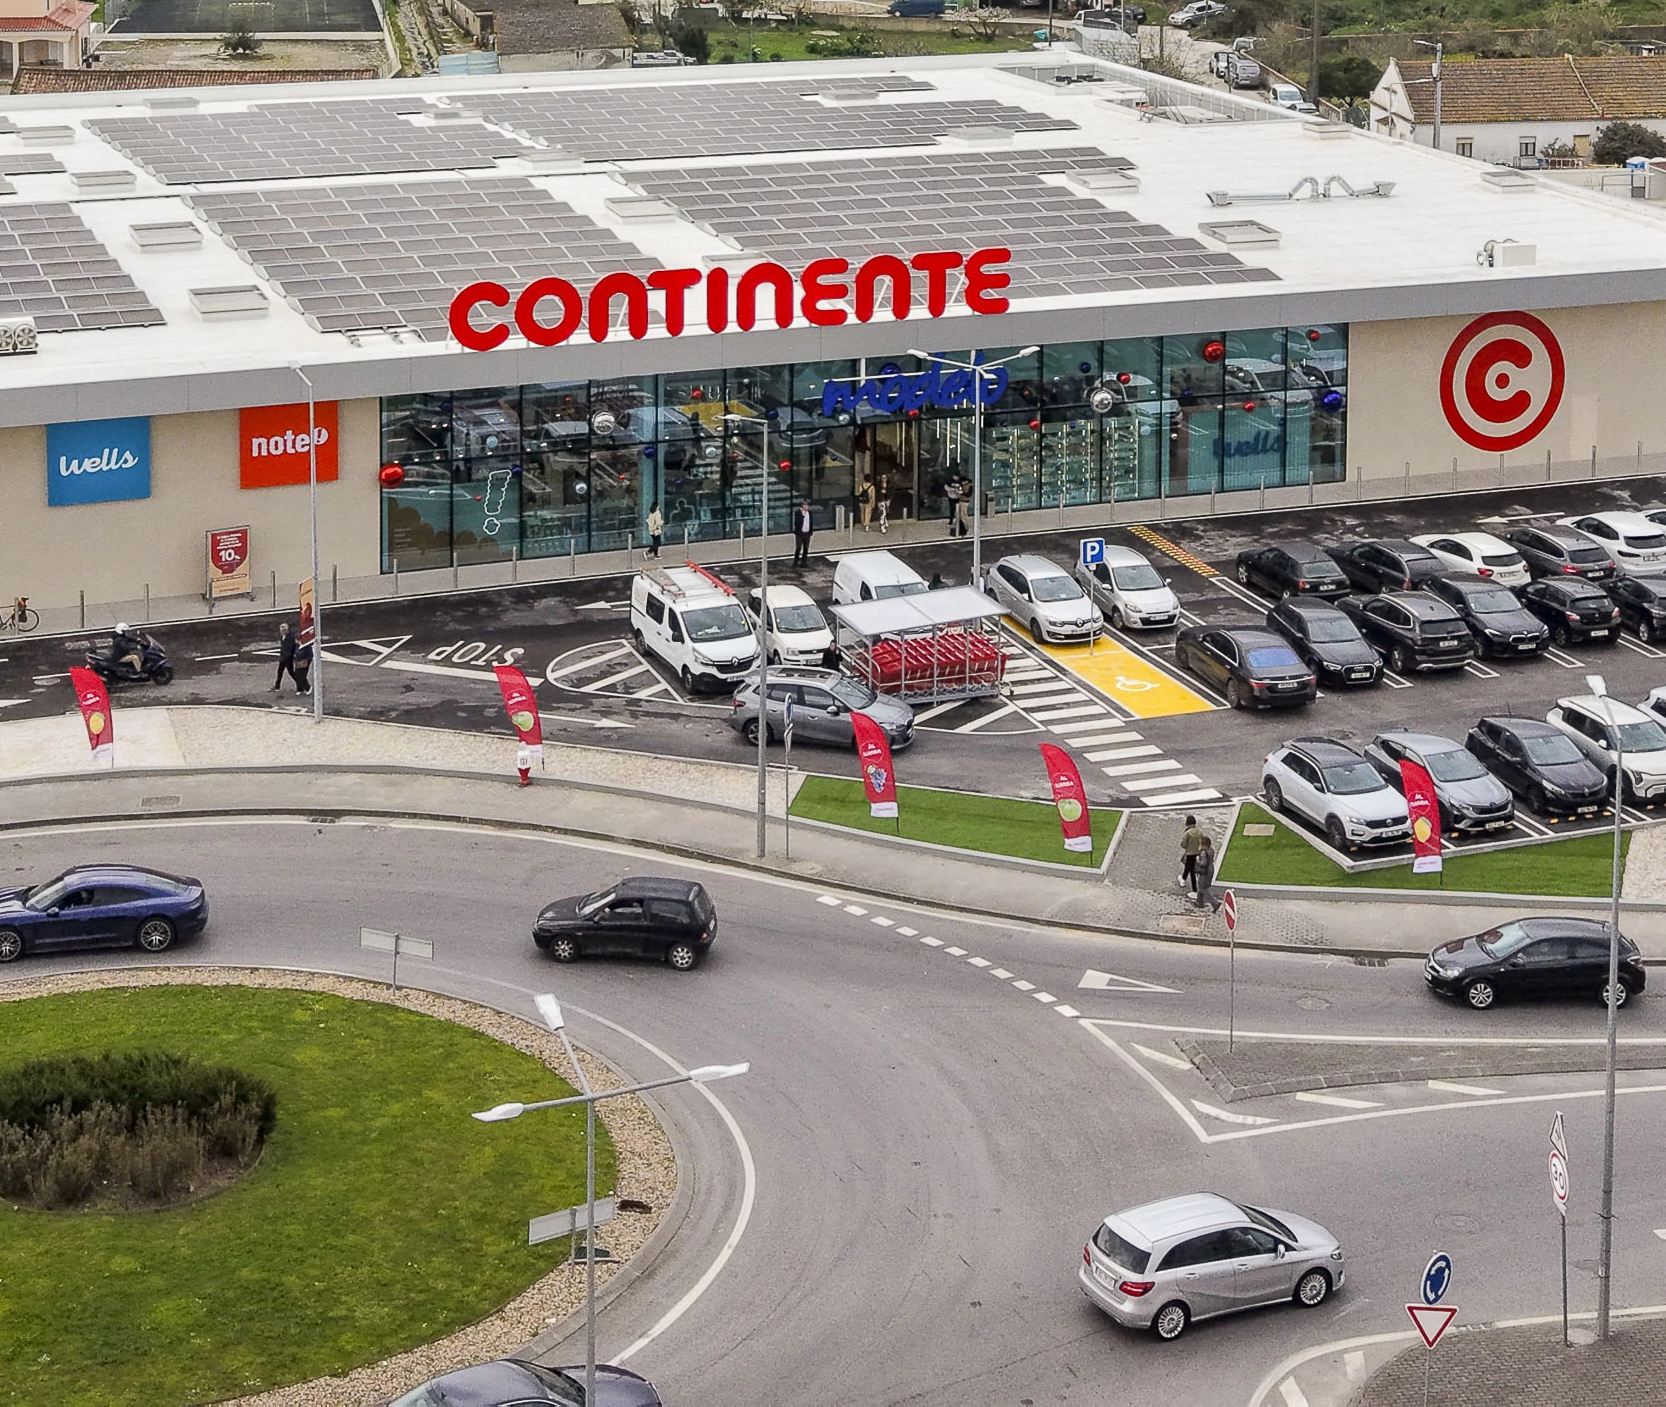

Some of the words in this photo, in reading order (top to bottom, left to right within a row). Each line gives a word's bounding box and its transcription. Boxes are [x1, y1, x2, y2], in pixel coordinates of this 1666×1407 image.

[449, 248, 1011, 352] CONTINENTE
[822, 350, 1009, 417] modelo
[59, 448, 139, 476] wells
[1086, 542, 1100, 562] P
[427, 640, 525, 667] STOP
[1551, 1162, 1566, 1190] 30
